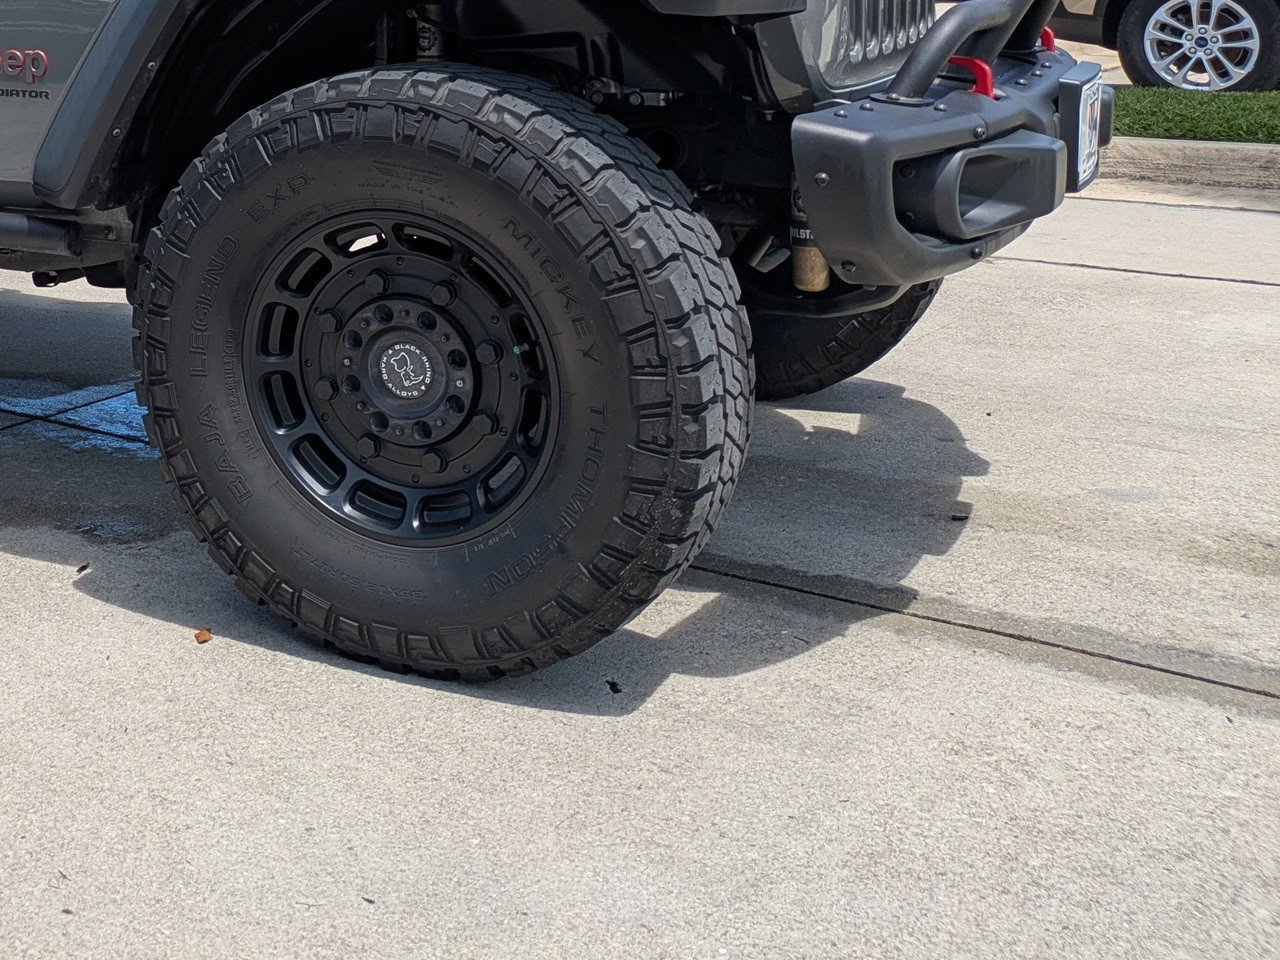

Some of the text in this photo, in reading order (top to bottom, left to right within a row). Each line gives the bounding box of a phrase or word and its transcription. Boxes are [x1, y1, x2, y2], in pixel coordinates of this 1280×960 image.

[190, 173, 311, 503] BAJA LEGEND EXP
[387, 383, 418, 396] ALLOYS
[394, 344, 431, 384] BLACK RHINO
[484, 215, 609, 595] MICKEY THOMPSON
